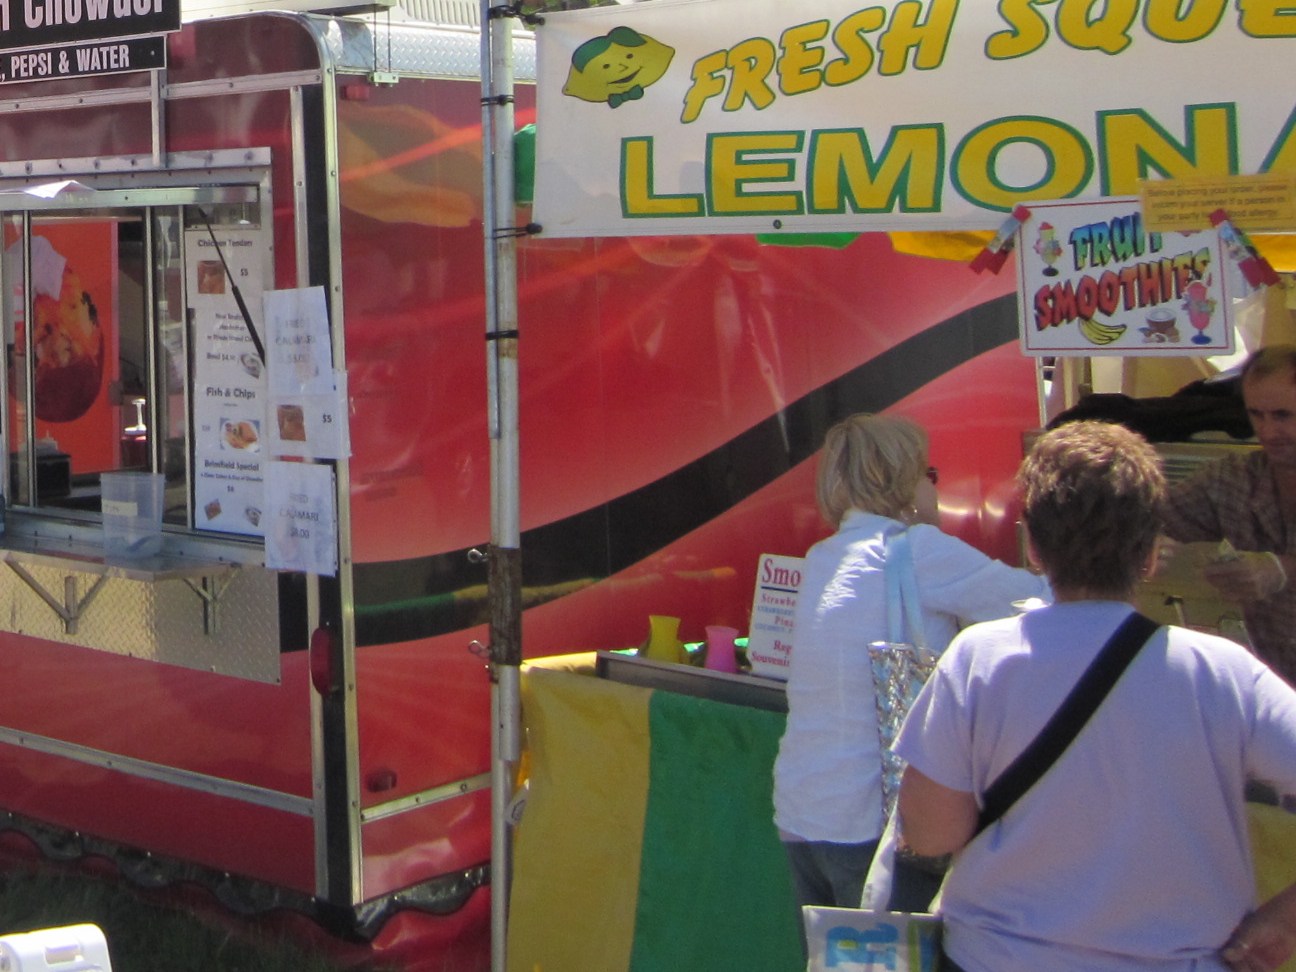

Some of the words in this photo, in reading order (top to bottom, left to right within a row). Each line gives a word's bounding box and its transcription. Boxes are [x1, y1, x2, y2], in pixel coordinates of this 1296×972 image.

[11, 51, 52, 78] PEPSI
[59, 50, 70, 74] &
[76, 44, 130, 71] WATER
[619, 101, 1296, 219] LEMON
[198, 239, 226, 247] Chicen
[1033, 246, 1212, 331] SMOOTHIES
[206, 387, 222, 397] Fish
[225, 388, 231, 397] &
[233, 388, 256, 399] Chips
[322, 413, 332, 423] $5
